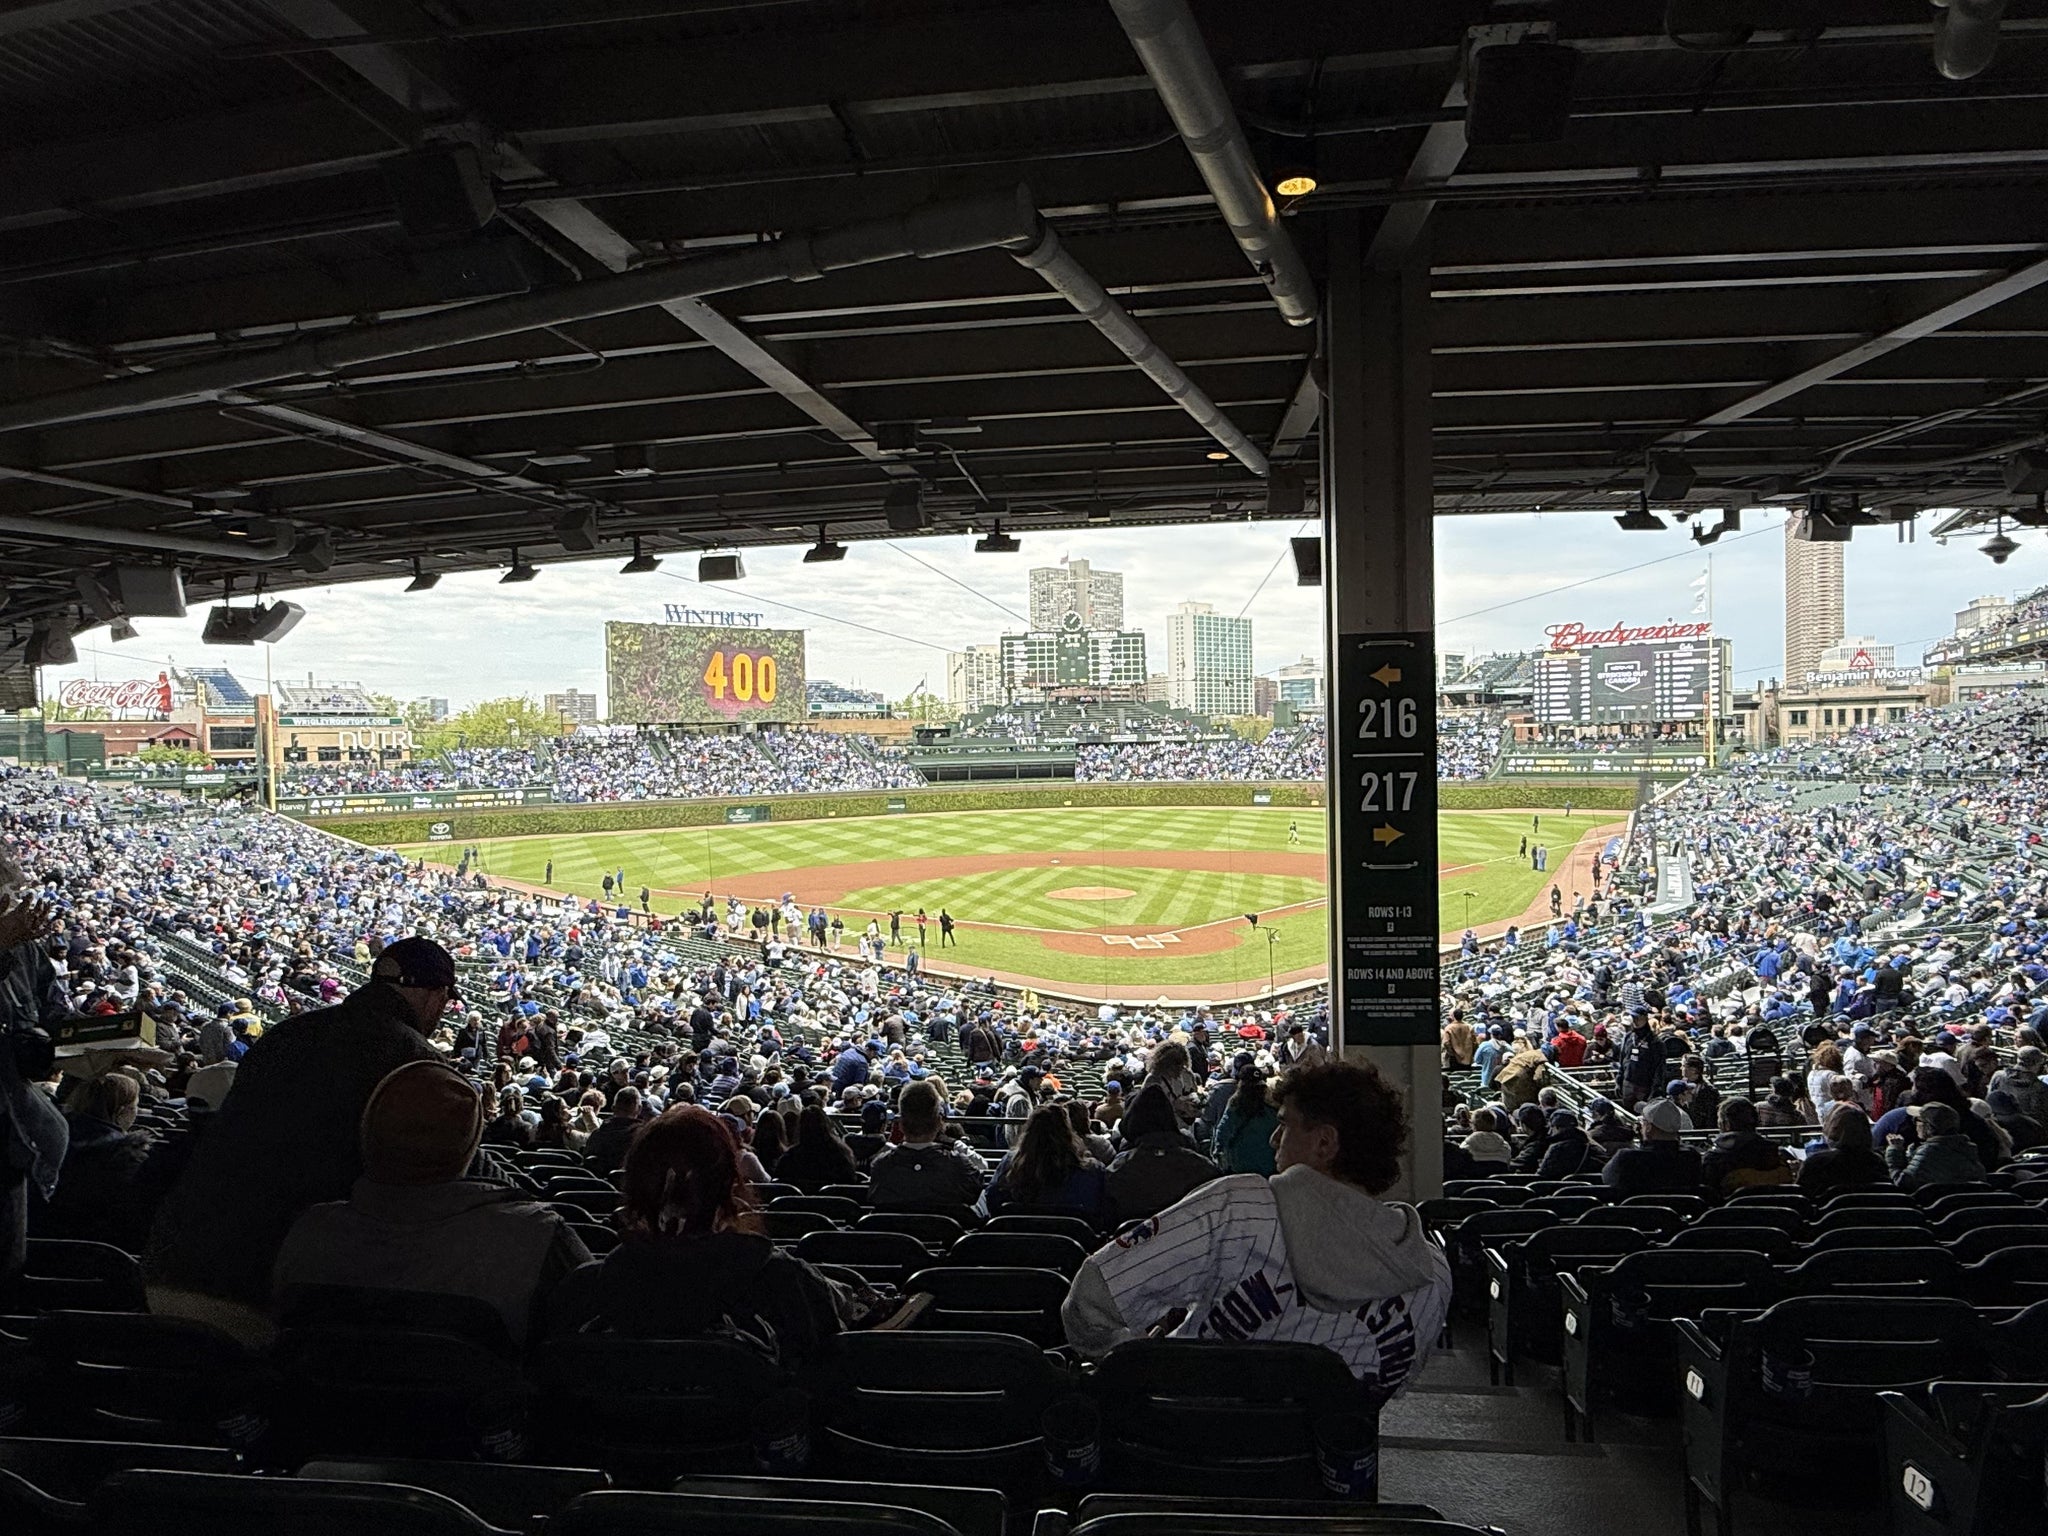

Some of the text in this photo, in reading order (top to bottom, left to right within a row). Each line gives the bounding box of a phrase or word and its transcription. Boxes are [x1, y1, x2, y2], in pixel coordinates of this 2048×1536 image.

[1544, 621, 1712, 648] Budweiser
[703, 651, 777, 703] 400
[1806, 666, 1920, 683] Benjamin Moore
[60, 679, 167, 709] Coca-Cola
[1359, 698, 1417, 738] 216
[1015, 737, 1036, 745] YETI
[1361, 772, 1418, 811] 217
[1368, 906, 1412, 918] ROWS 1-13
[1347, 967, 1435, 980] ROWS 14 AND ABOVE
[1690, 1374, 1701, 1394] 11
[1911, 1473, 1927, 1501] 12
